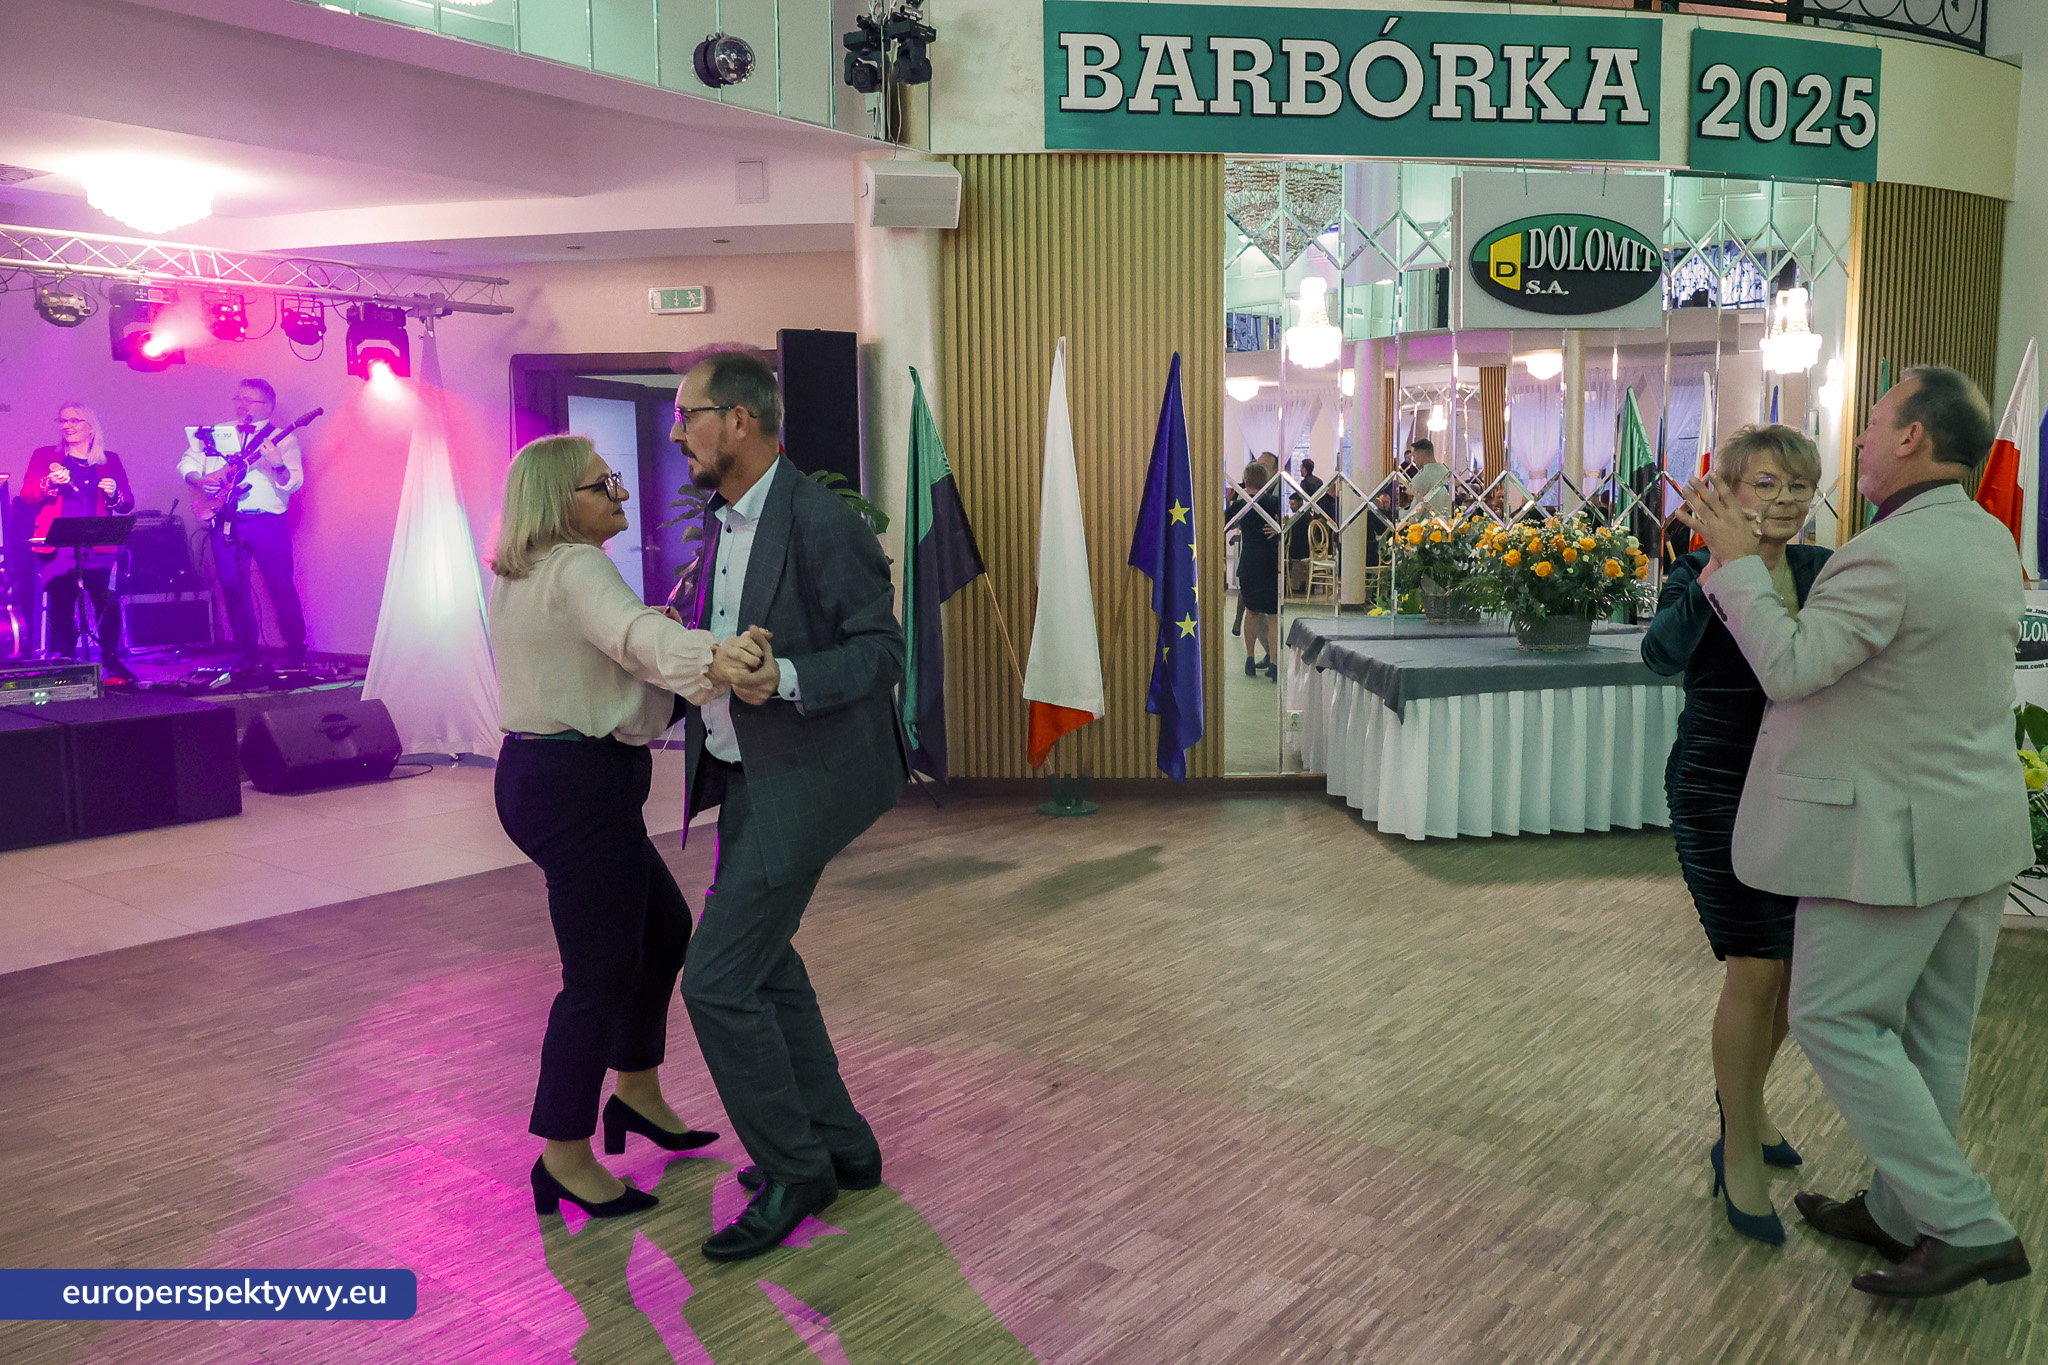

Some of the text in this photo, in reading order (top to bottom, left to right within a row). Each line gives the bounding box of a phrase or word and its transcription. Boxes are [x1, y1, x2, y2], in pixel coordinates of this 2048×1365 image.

[1059, 17, 1650, 124] BARBÓRKA
[1699, 63, 1876, 149] 2025
[1496, 261, 1517, 277] D
[1527, 224, 1657, 272] DOLOMIT
[1525, 280, 1570, 295] S.A.
